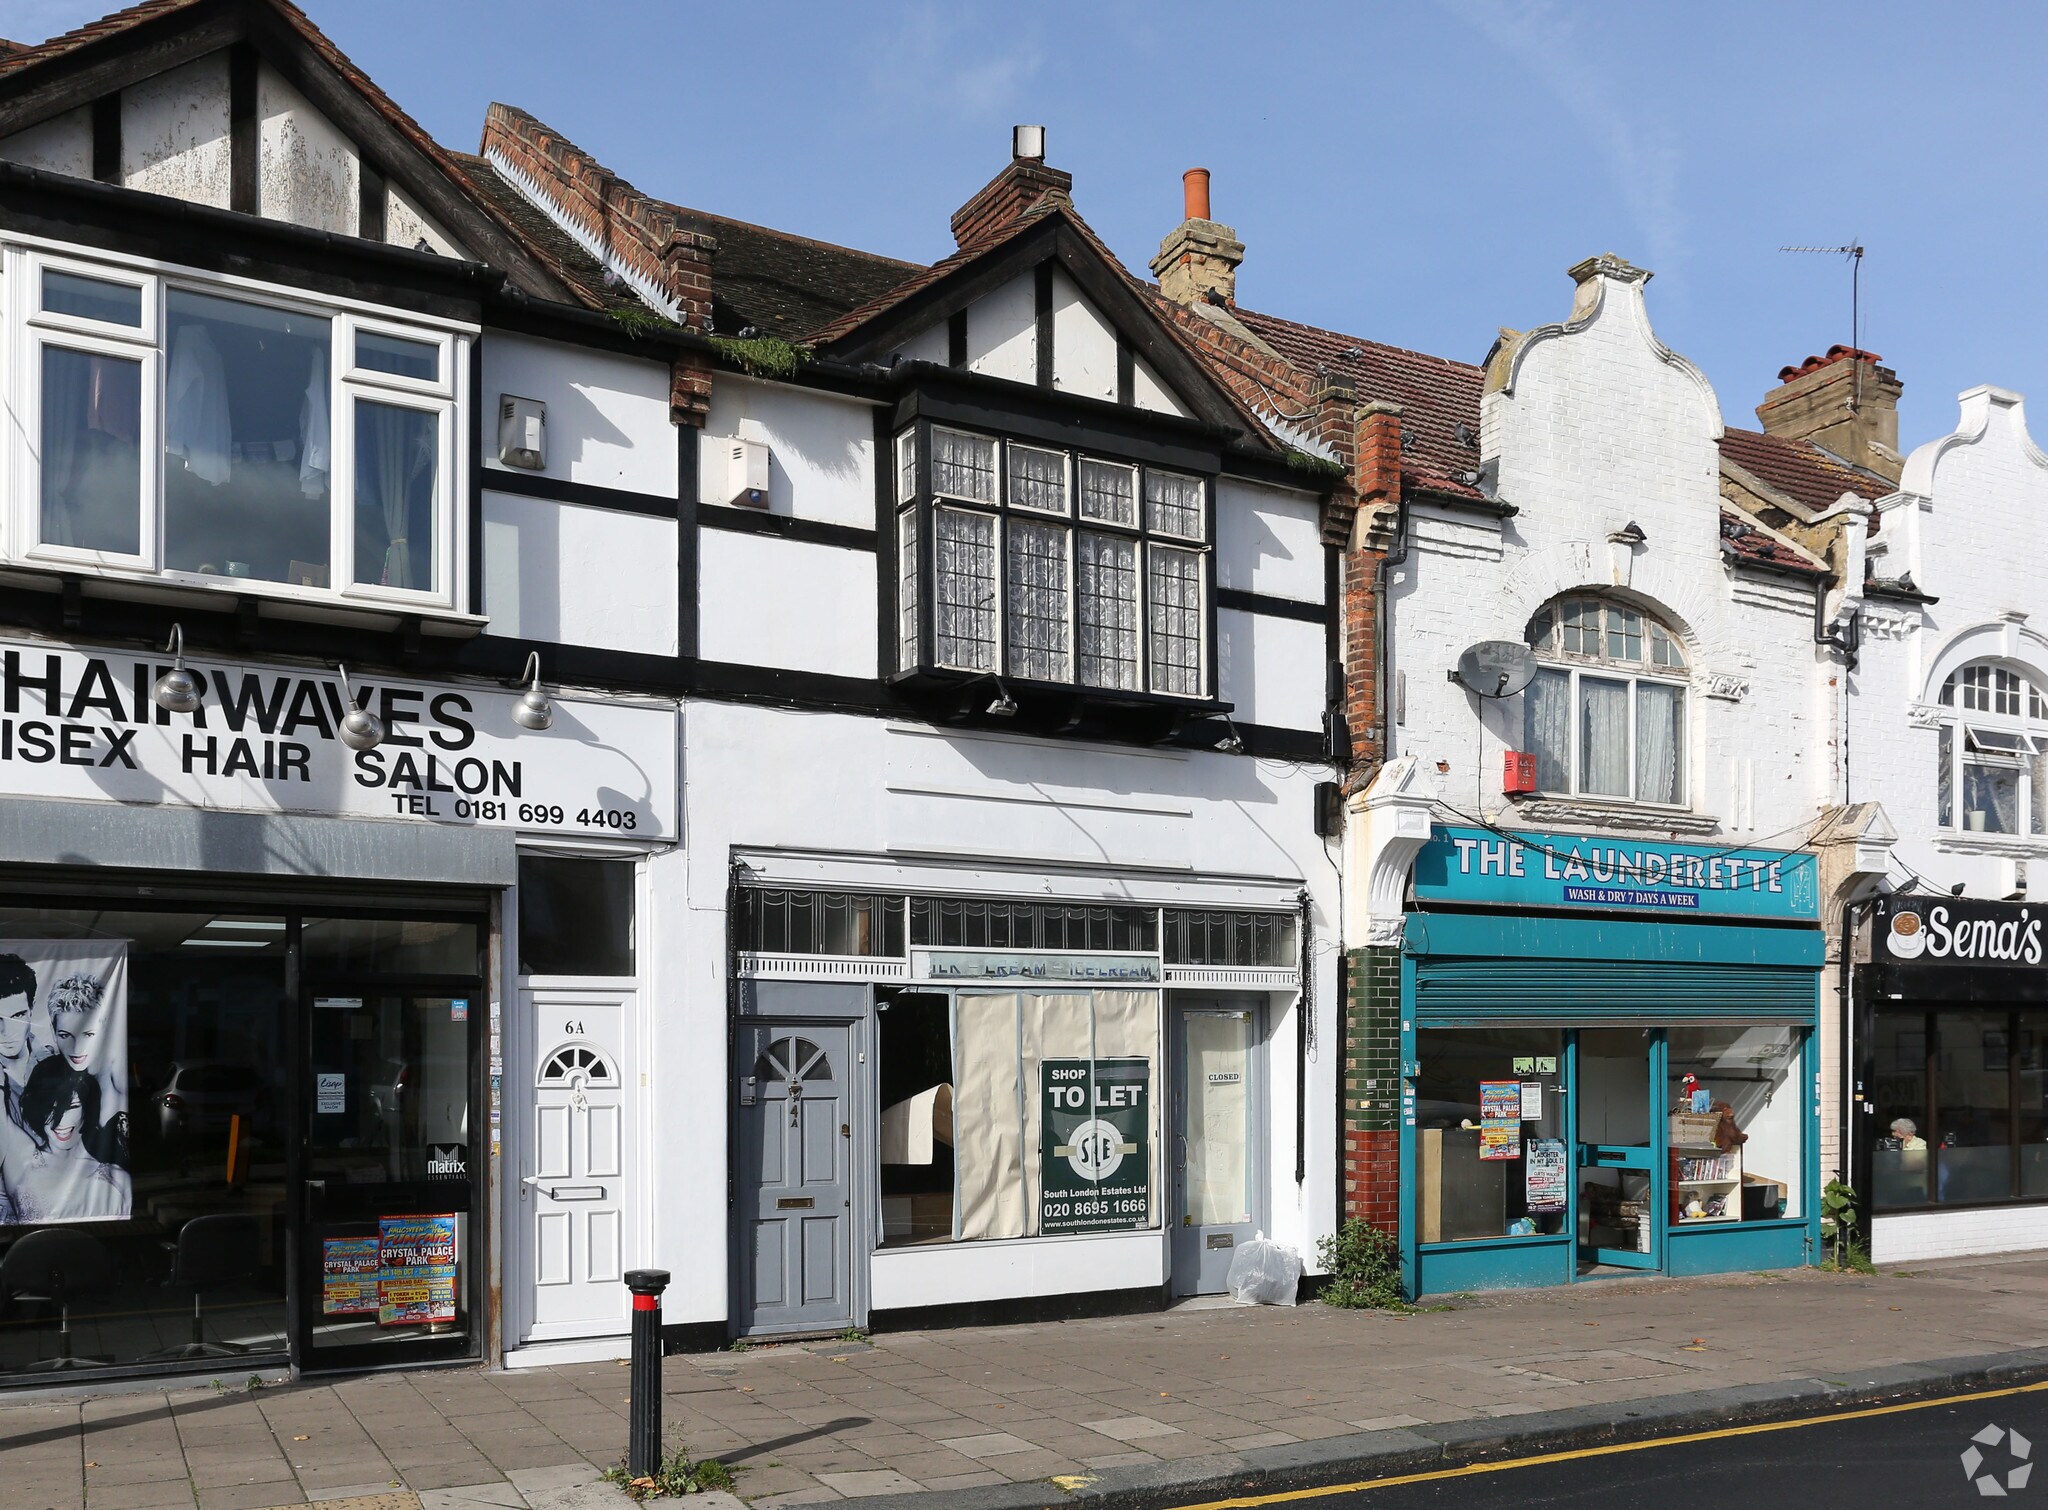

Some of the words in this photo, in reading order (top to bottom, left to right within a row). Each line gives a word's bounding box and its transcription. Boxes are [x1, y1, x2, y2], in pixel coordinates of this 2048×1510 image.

[182, 734, 311, 781] HAIR
[353, 749, 522, 798] SALON
[391, 793, 440, 816] TEL
[454, 799, 507, 821] 0181
[519, 803, 565, 824] 699
[576, 808, 637, 830] 4403
[1452, 838, 1526, 877] THE
[1543, 845, 1783, 893] LAUNDERETTE
[1568, 888, 1596, 900] WASH
[1598, 890, 1606, 901] &
[1607, 891, 1626, 902] DRY
[1628, 892, 1634, 903] 7
[1636, 892, 1658, 904] DAYS
[1660, 894, 1667, 904] A
[1668, 894, 1695, 906] WEEK
[1876, 899, 1886, 916] 2
[1926, 906, 2042, 965] Sema's
[565, 1020, 585, 1034] 6A
[1051, 1069, 1086, 1080] SHOP
[1208, 1073, 1239, 1081] CLOSED
[1048, 1086, 1086, 1108] TO
[1095, 1085, 1143, 1107] LET
[427, 1160, 466, 1174] Matrix
[1044, 1189, 1068, 1199] South
[1070, 1188, 1099, 1197] London
[1101, 1186, 1132, 1196] Estates
[1133, 1185, 1147, 1194] Ltd
[1044, 1203, 1070, 1217] 020
[1074, 1201, 1109, 1216] 8695
[1113, 1199, 1146, 1213] 1666
[1044, 1216, 1147, 1228] www.southlondonestates.co.uk
[381, 1248, 418, 1258] CRYSTAL
[421, 1246, 453, 1256] PALACE
[406, 1256, 428, 1265] PARK
